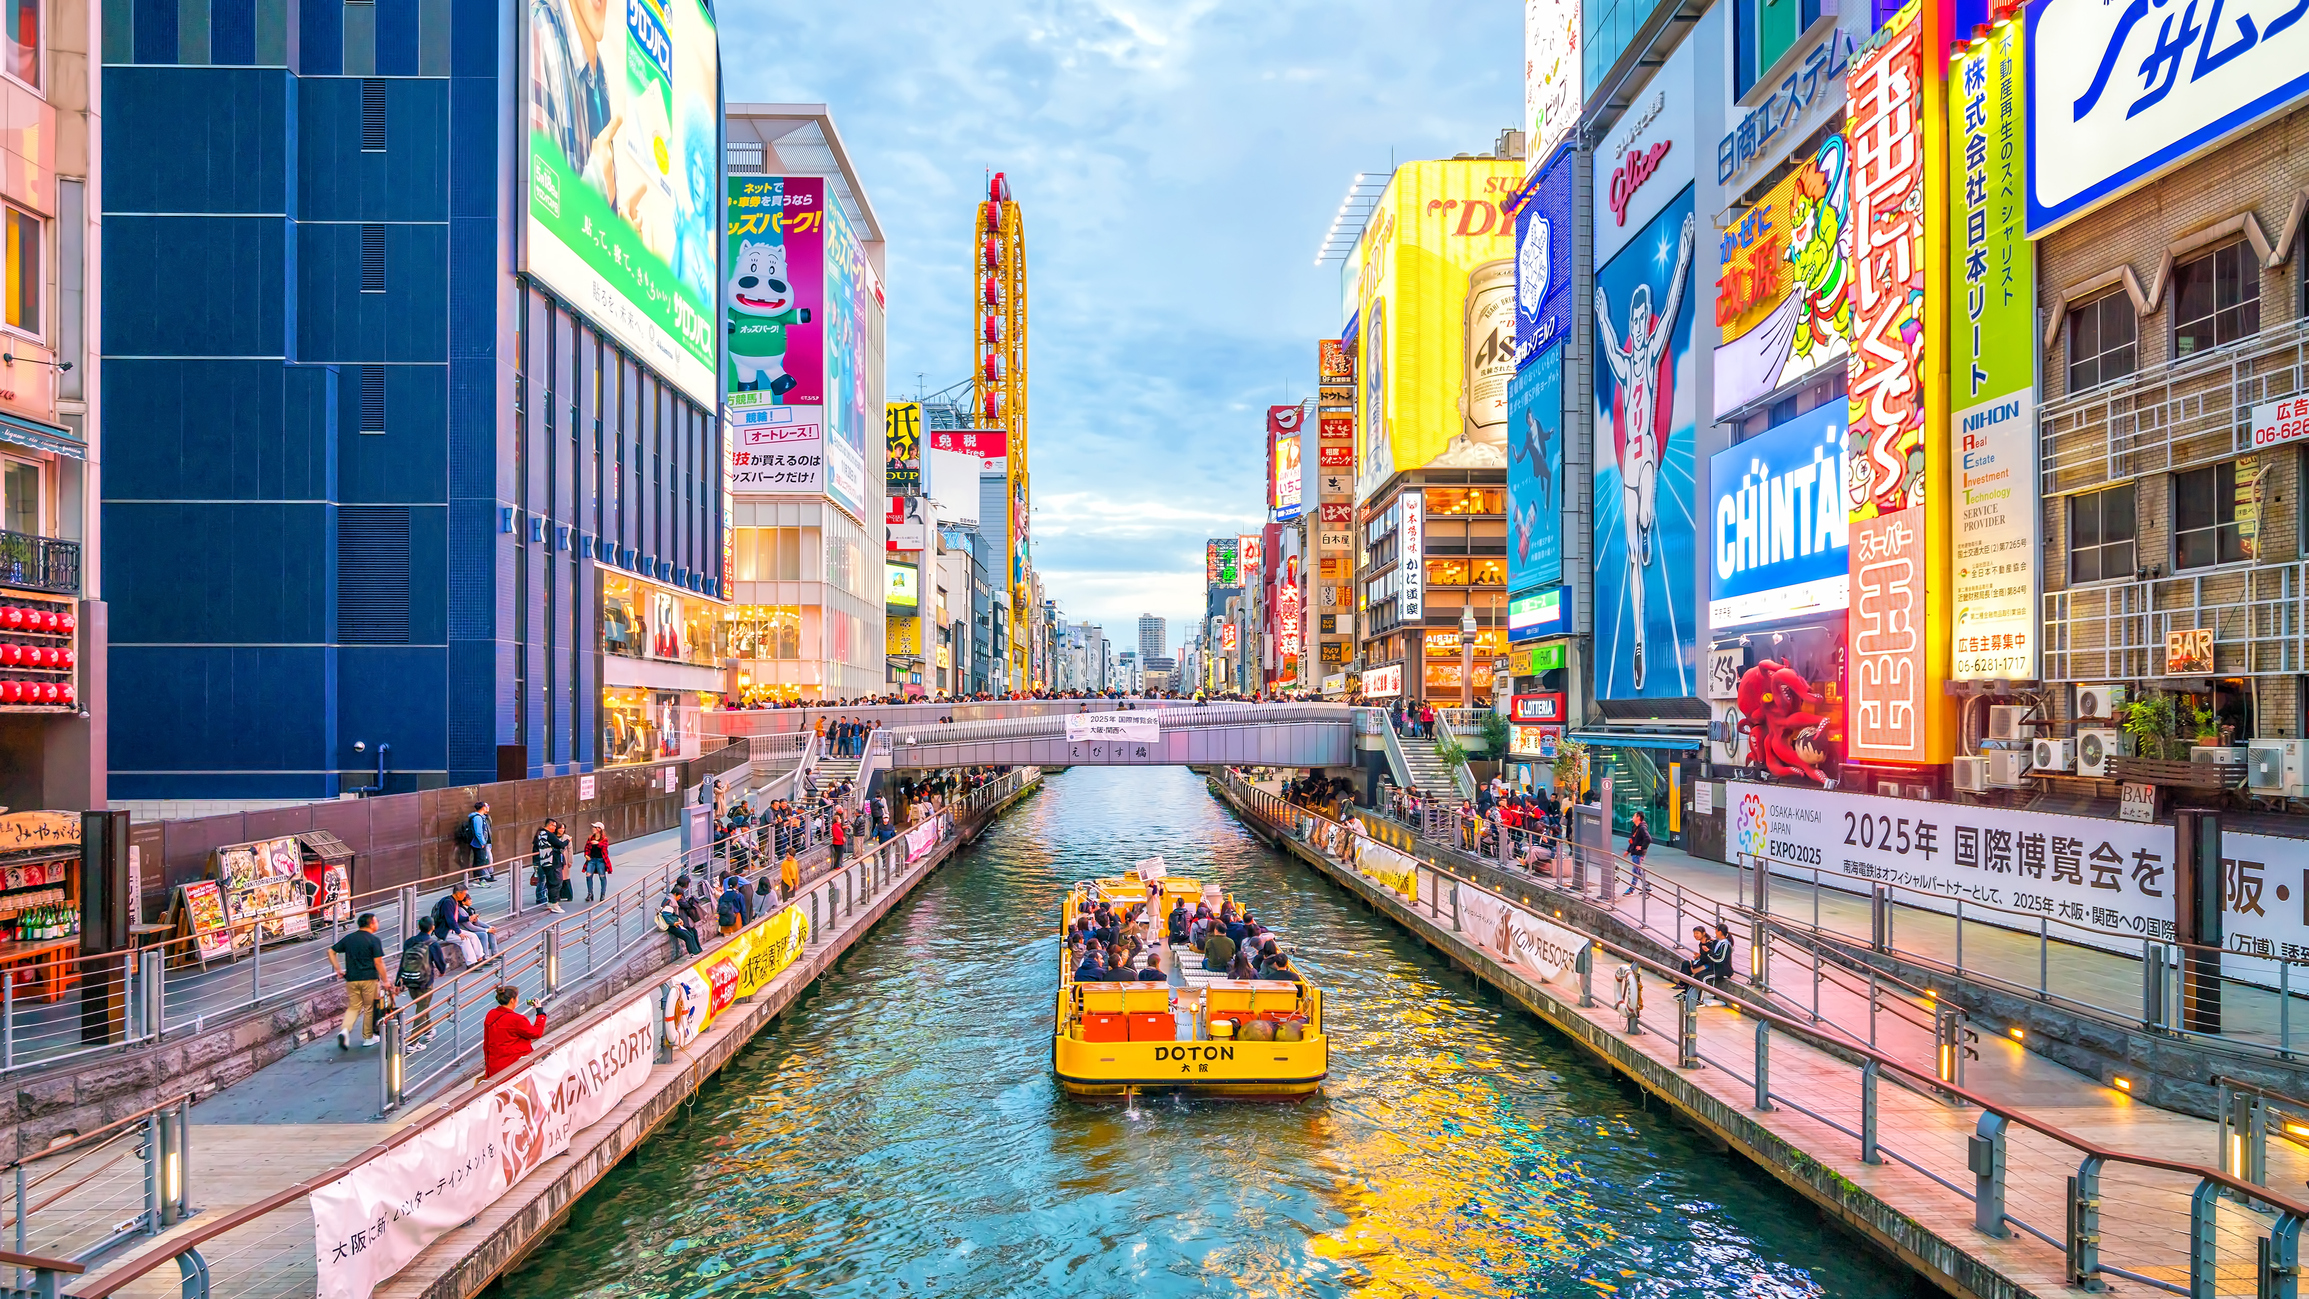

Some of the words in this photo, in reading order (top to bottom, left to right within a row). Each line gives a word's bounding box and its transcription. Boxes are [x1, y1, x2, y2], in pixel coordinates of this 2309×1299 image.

[1718, 28, 1858, 186] 日商エステム
[1999, 34, 2014, 307] 不動産再生のスペシャリスト
[743, 182, 784, 194] ネットで
[1609, 140, 1672, 227] Glico
[728, 194, 813, 208] ・車券を買うなら
[1720, 204, 1773, 265] かぜに
[1964, 56, 1988, 395] 株式会社日本リート
[1715, 233, 1781, 327] 改源
[674, 291, 713, 359] サロンパス
[746, 411, 773, 424] 競輪！
[1633, 377, 1644, 460] グリコ
[1963, 401, 2019, 434] NIHON
[2277, 398, 2309, 421] 広告
[751, 427, 812, 442] オートレース！
[939, 434, 977, 447] 免税
[1963, 434, 1987, 452] Real
[1963, 452, 1995, 470] Estate
[1963, 468, 2009, 488] Investment
[1962, 487, 2012, 505] Technology
[1322, 505, 1351, 521] はや
[1963, 503, 1998, 520] SERVICE
[1964, 514, 2006, 532] PROVIDER
[1322, 534, 1350, 545] 白木屋
[1406, 513, 1418, 554] 本場の味
[1858, 521, 1913, 562] スーパー
[1972, 562, 2027, 578] 全日本不動産協会
[1406, 558, 1419, 615] かに道楽
[1958, 633, 2026, 653] 広告主募集中
[2168, 630, 2211, 659] BAR
[1855, 557, 1917, 750] 玉出
[1838, 647, 1845, 682] 2F
[1958, 656, 2026, 673] 06-6281-1717
[1524, 700, 1553, 715] LOTTERIA
[1090, 715, 1116, 724] 2025年
[1118, 715, 1159, 725] 国際博覧会を
[1090, 727, 1126, 735] 大阪・関西へ
[1072, 747, 1147, 758] えびす橋
[2122, 785, 2153, 805] BAR
[1770, 804, 1822, 824] OSAKA-KANSAI
[2122, 807, 2151, 819] ふたごや
[1770, 821, 1791, 836] JAPAN
[1843, 811, 1939, 861] 2025年
[1770, 841, 1822, 866] EXPO2025
[1843, 859, 2003, 905] 南海電鉄はオフィシャルパートナーとして、
[2013, 892, 2054, 913] 2025年
[1510, 924, 1535, 953] MGM
[1154, 1046, 1235, 1061] DOTON
[547, 1067, 590, 1121] MGM
[588, 1022, 652, 1093] RESORTS
[1181, 1063, 1209, 1073] 大阪
